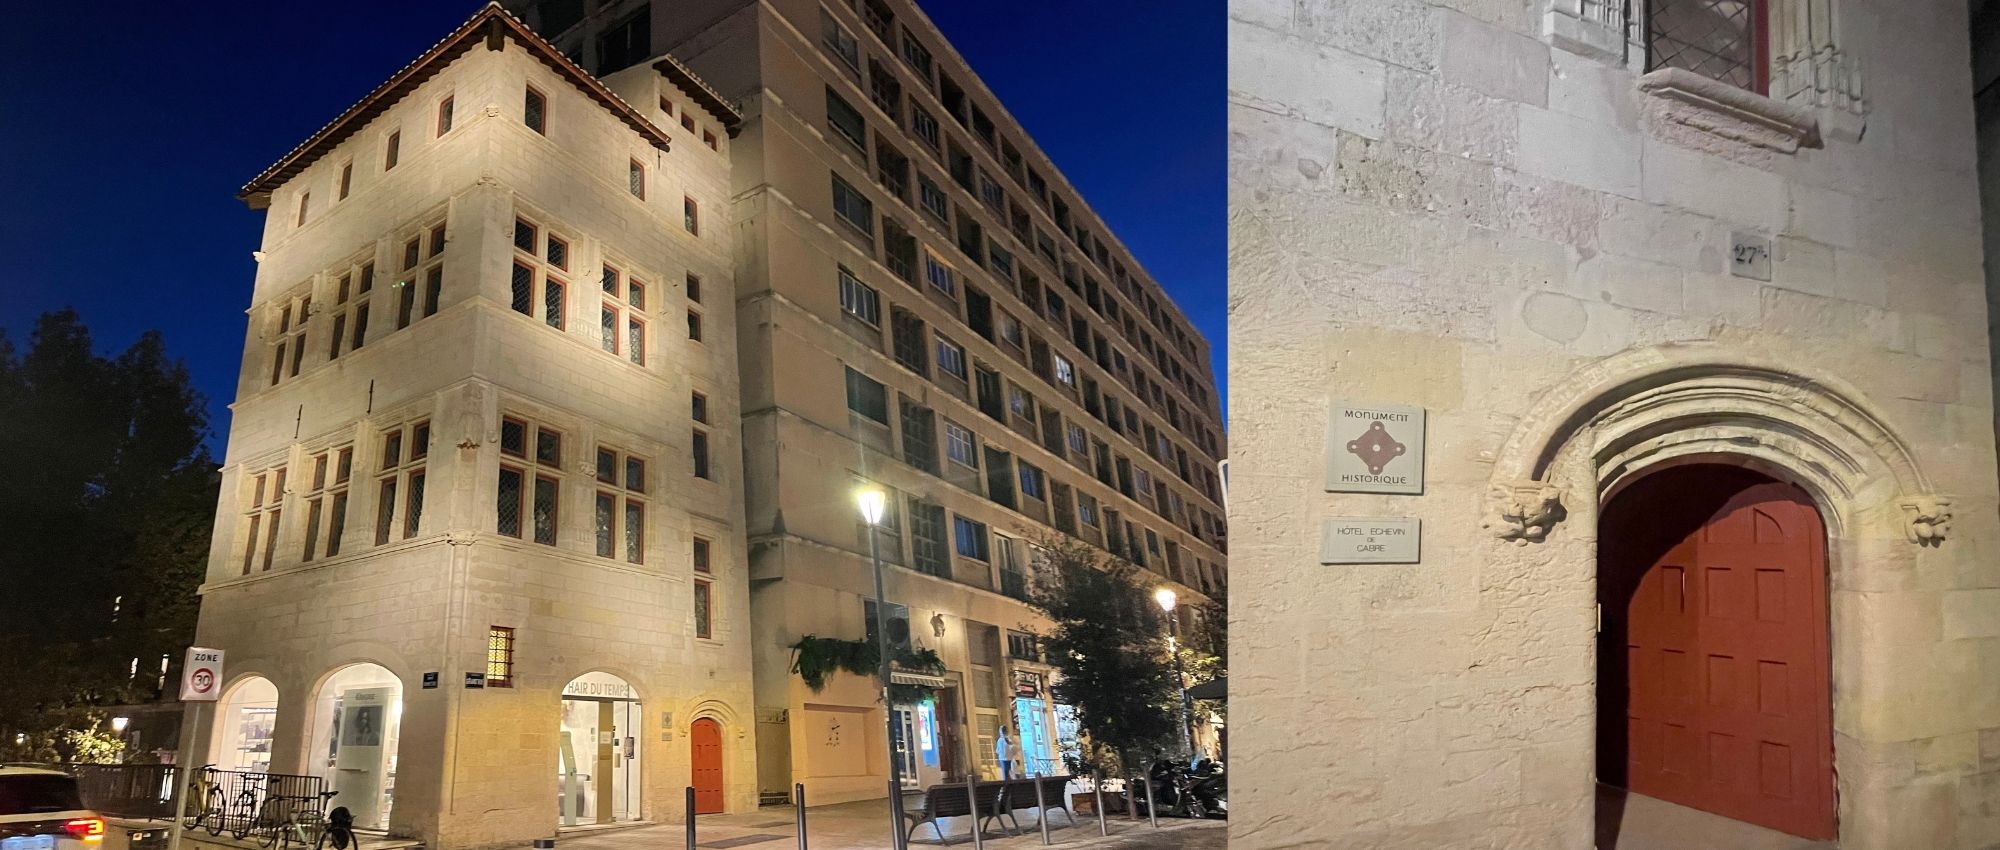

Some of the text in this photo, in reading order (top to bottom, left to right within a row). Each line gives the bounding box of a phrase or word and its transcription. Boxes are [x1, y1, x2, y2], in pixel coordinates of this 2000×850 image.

[1344, 410, 1409, 422] MONUMENT
[1341, 474, 1407, 485] HISTORIQUE
[1356, 544, 1386, 552] CABRE
[194, 653, 219, 662] ZONE
[196, 674, 210, 687] 30
[568, 681, 628, 697] HAIR DU TEMPS
